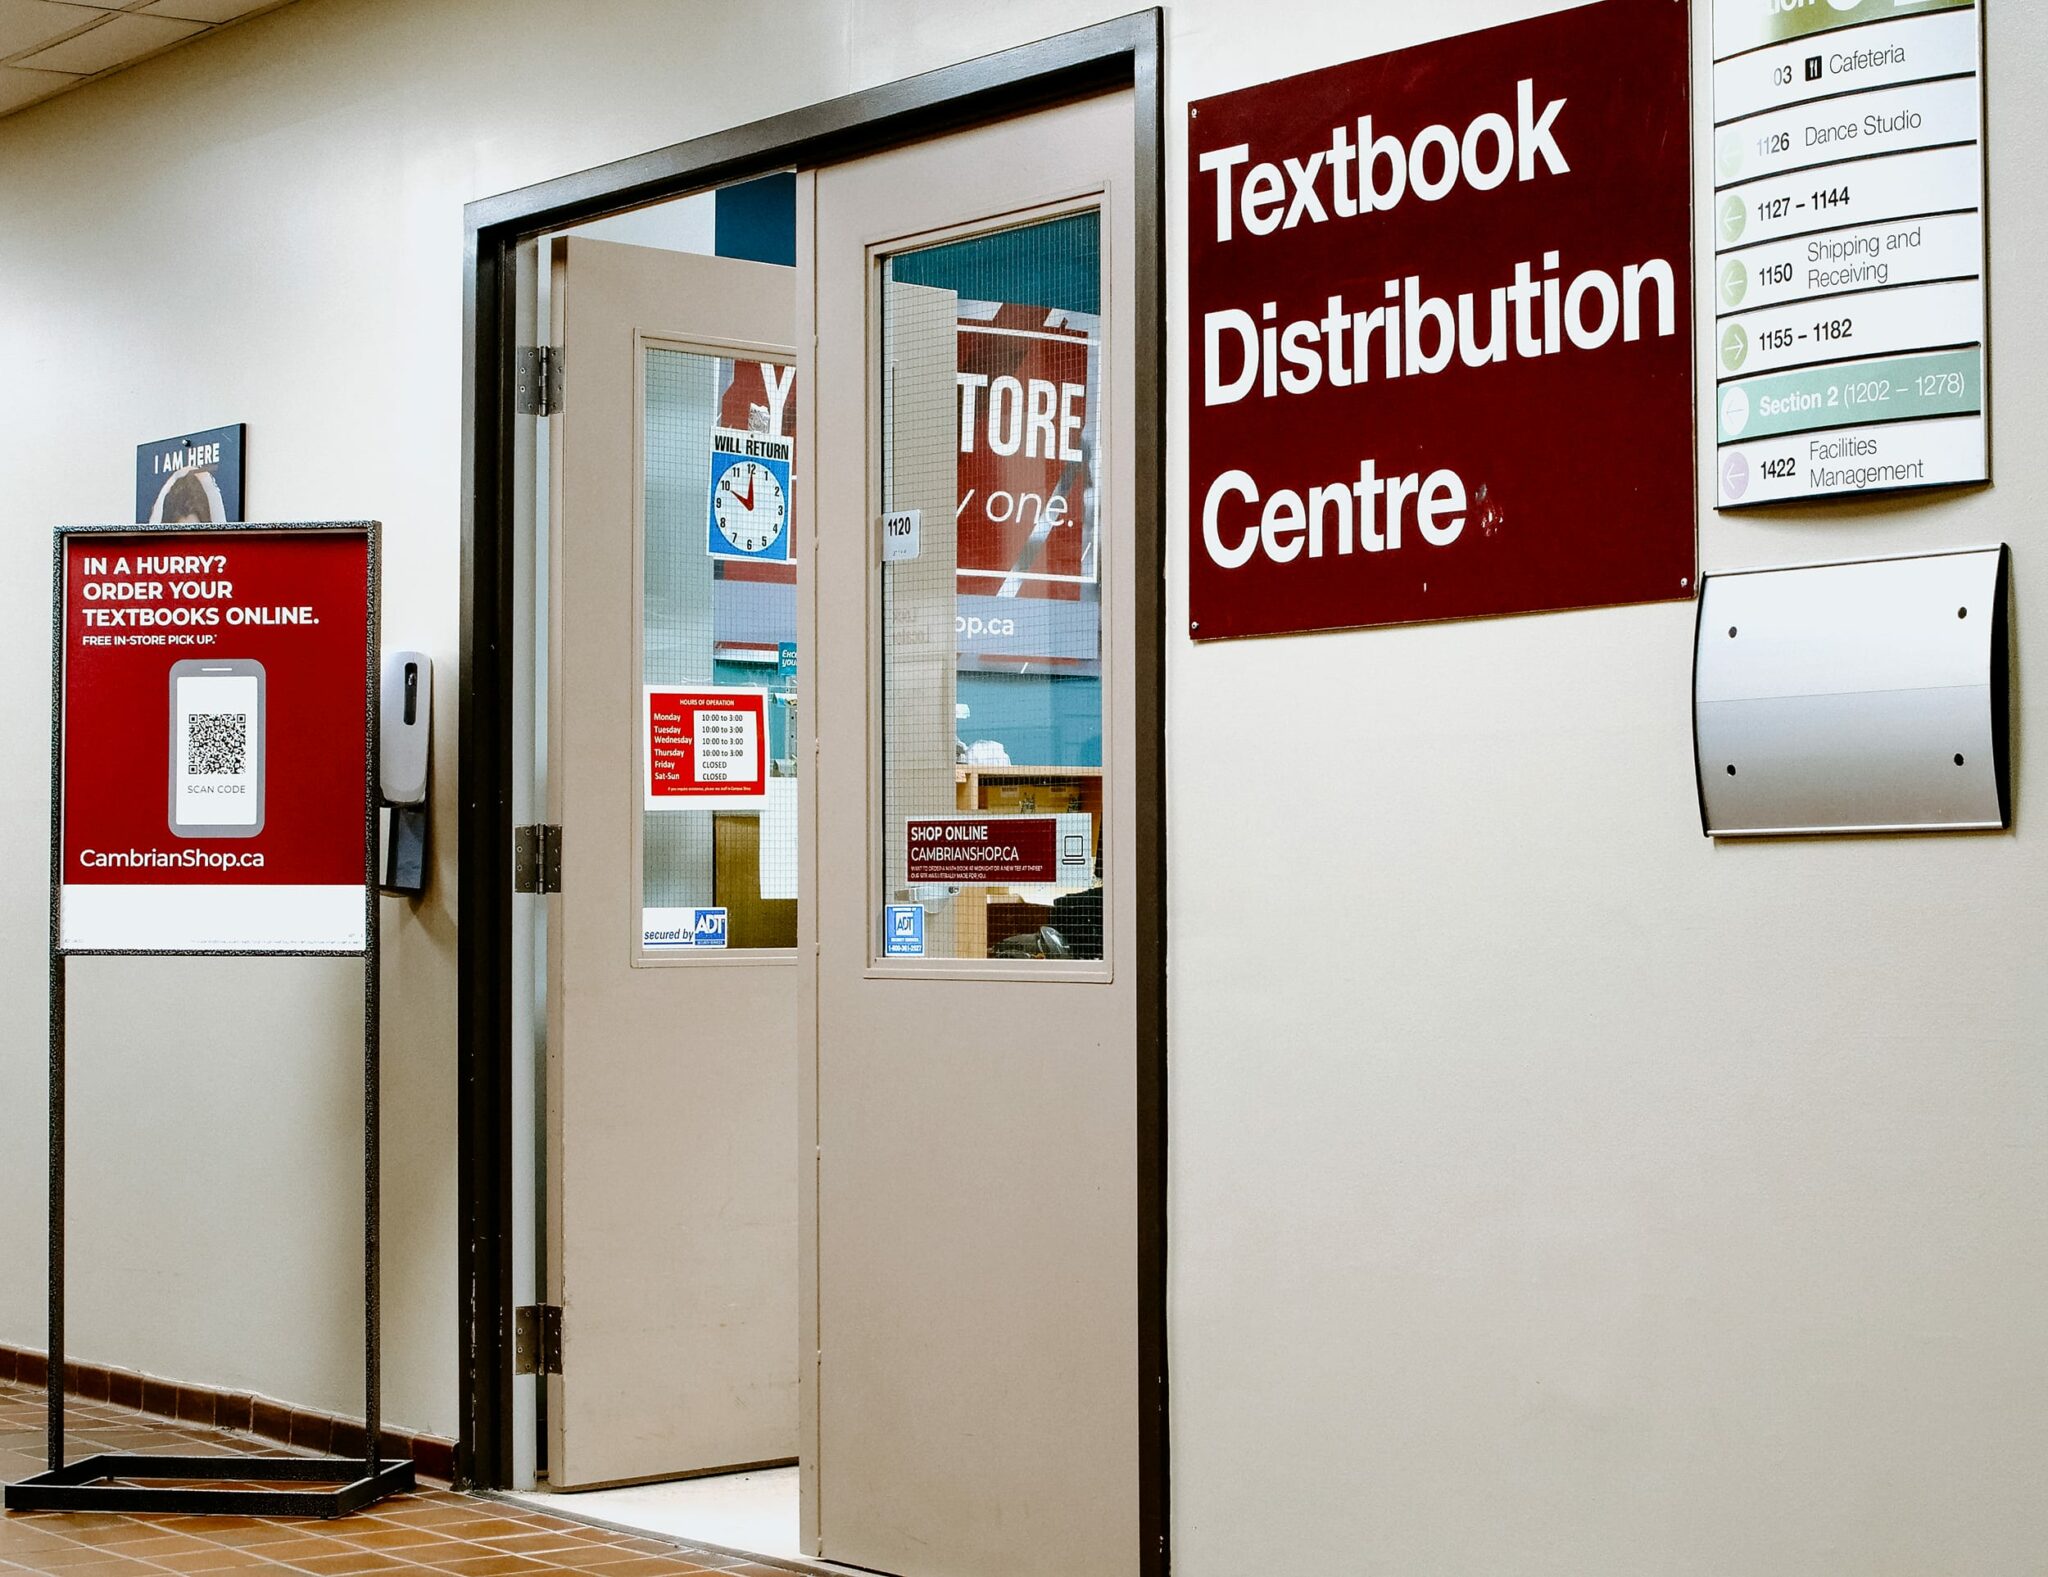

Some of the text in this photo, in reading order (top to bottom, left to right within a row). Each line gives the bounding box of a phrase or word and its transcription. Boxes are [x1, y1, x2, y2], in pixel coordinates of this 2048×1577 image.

[1829, 44, 1906, 75] Cafeteria
[1757, 110, 1922, 157] 1126 Dance Studio
[1199, 78, 1571, 242] Textbook
[1757, 197, 1791, 221] 1127
[1811, 186, 1850, 210] 1144
[1807, 227, 1921, 262] Shipping and
[1759, 263, 1793, 286] 1150
[1808, 262, 1889, 289] Receiving
[1204, 249, 1675, 407] Distribution
[1759, 327, 1793, 351] 1155
[1813, 318, 1853, 342] 1182
[1759, 392, 1822, 417] Section
[1827, 386, 1839, 407] 2
[1843, 380, 1890, 409] (1202
[1915, 372, 1965, 398] 1278)
[715, 435, 789, 460] WILL RETURN
[1810, 437, 1877, 460] Facilities
[154, 442, 219, 474] I AM HERE
[732, 467, 740, 478] 11
[747, 463, 756, 475] 12
[764, 470, 769, 481] 1
[1761, 457, 1796, 480] 1422
[1810, 459, 1924, 489] Management
[721, 480, 731, 491] 10
[774, 486, 780, 497] 2
[716, 498, 722, 508] 9
[778, 505, 784, 516] 3
[986, 490, 1074, 527] one.
[1202, 458, 1467, 569] Centre
[720, 517, 726, 529] 8
[772, 523, 778, 534] 4
[888, 517, 911, 536] 1120
[732, 533, 737, 543] 7
[747, 539, 752, 550] 6
[761, 536, 767, 547] 5
[83, 555, 227, 575] IN A HURRY?
[82, 581, 233, 600] ORDER YOUR
[82, 606, 319, 626] TEXTBOOKS ONLINE.
[82, 635, 111, 645] FREE
[114, 635, 166, 645] IN-STORE
[168, 635, 195, 645] PICK
[654, 713, 681, 722] Monday
[654, 726, 743, 734] Tuesday 10:00 to 3:00
[654, 736, 692, 746] Wednesday
[655, 749, 684, 758] Thursday
[655, 761, 675, 769] Friday
[655, 772, 680, 780] Sat-Sun
[187, 785, 246, 794] SCAN CODE
[911, 825, 988, 841] SHOP ONLINE
[80, 848, 264, 871] CambrianShop.ca
[911, 846, 1019, 862] CAMBRIANSHOP.CA
[644, 914, 726, 941] secured by ADT
[896, 916, 913, 931] ADT
